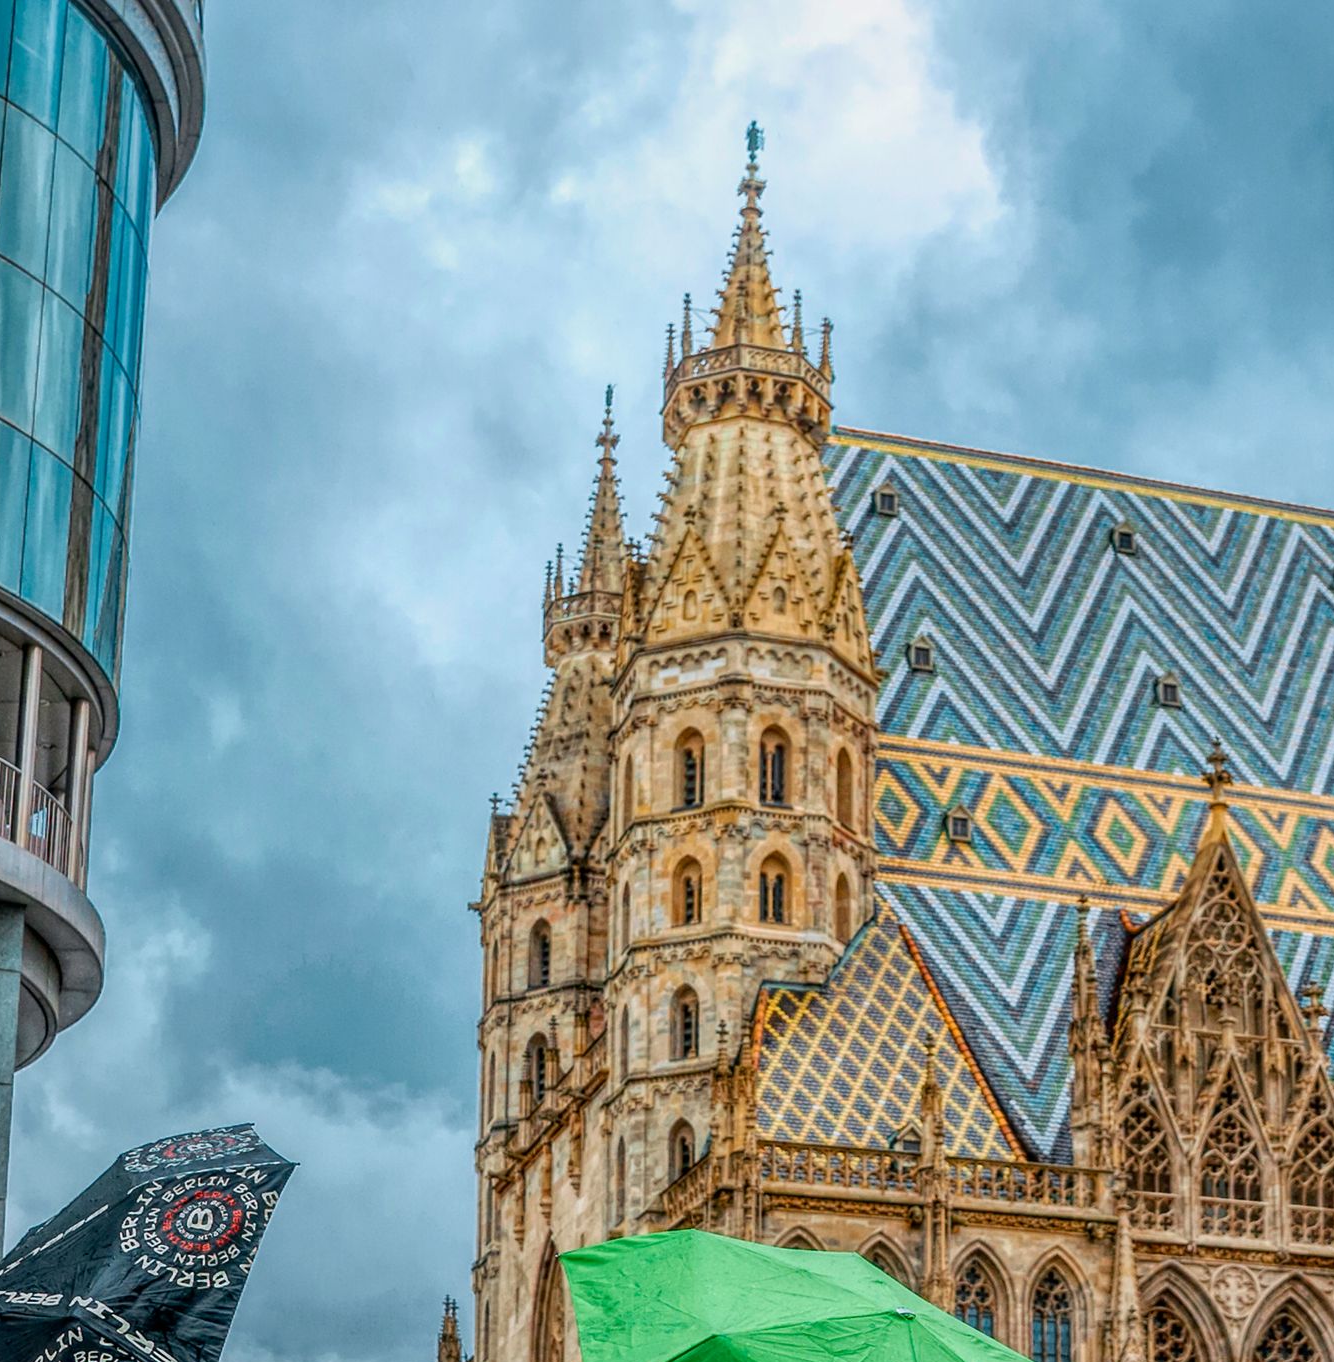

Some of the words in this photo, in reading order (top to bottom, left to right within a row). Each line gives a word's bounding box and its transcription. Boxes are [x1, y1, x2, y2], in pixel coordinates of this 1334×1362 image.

[162, 1176, 230, 1202] BERLIN
[120, 1180, 162, 1252] BERLIN
[186, 1207, 214, 1231] B
[233, 1183, 258, 1242] BERLIN
[144, 1207, 169, 1255] BERLIN
[135, 1254, 230, 1289] BERLIN
[173, 1244, 240, 1266] BERLIN
